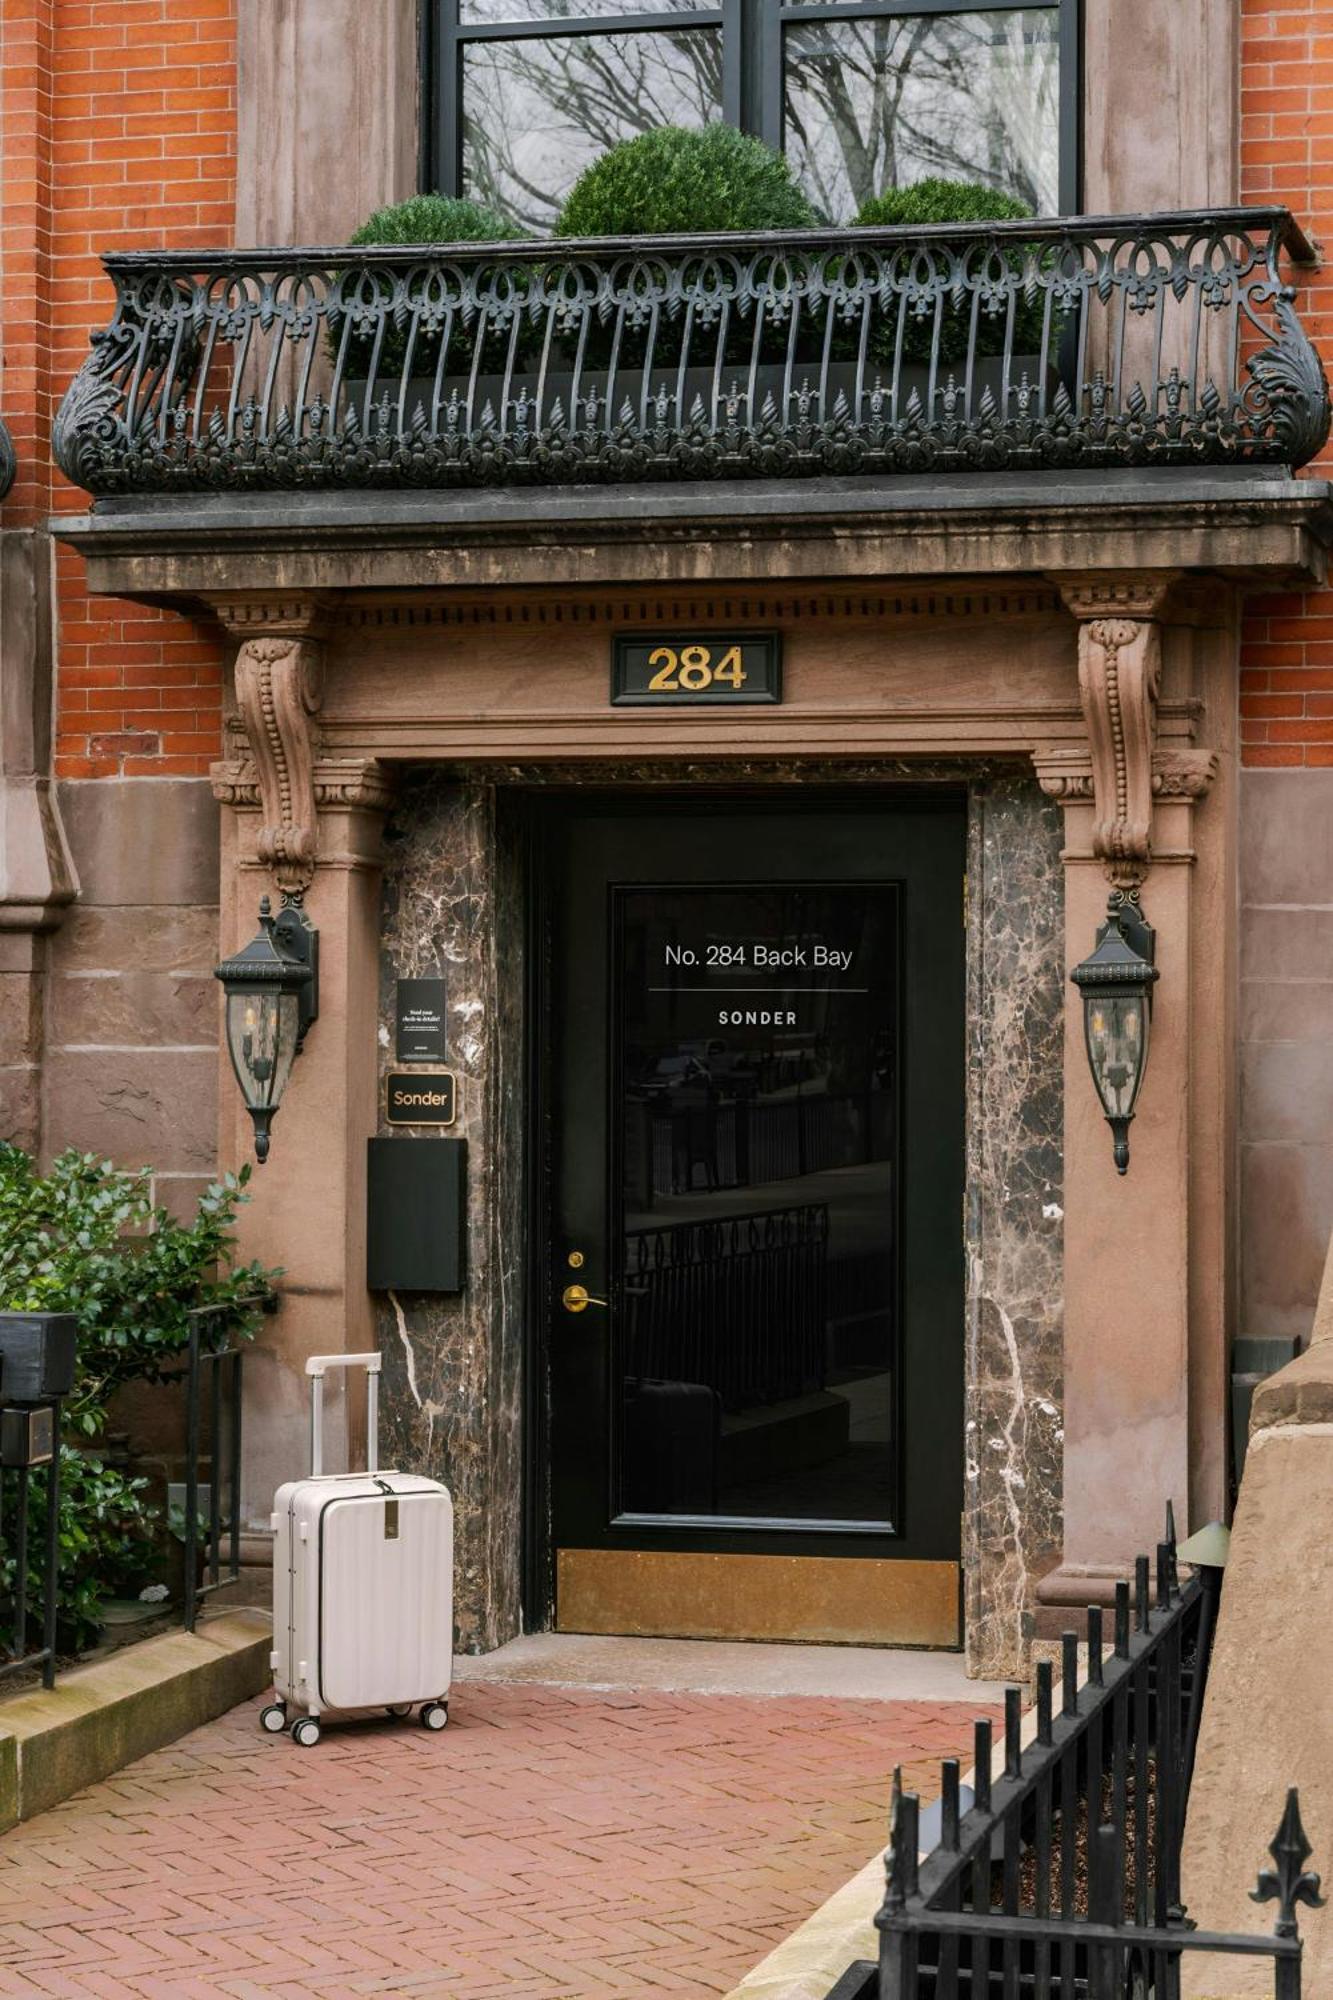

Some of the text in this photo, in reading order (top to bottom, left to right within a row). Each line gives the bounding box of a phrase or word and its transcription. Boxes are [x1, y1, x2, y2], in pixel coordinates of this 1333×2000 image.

[648, 646, 747, 690] 284
[665, 945, 853, 971] No. 284 Back Bay
[718, 1011, 797, 1025] SONDER
[394, 1090, 448, 1106] Sonder
